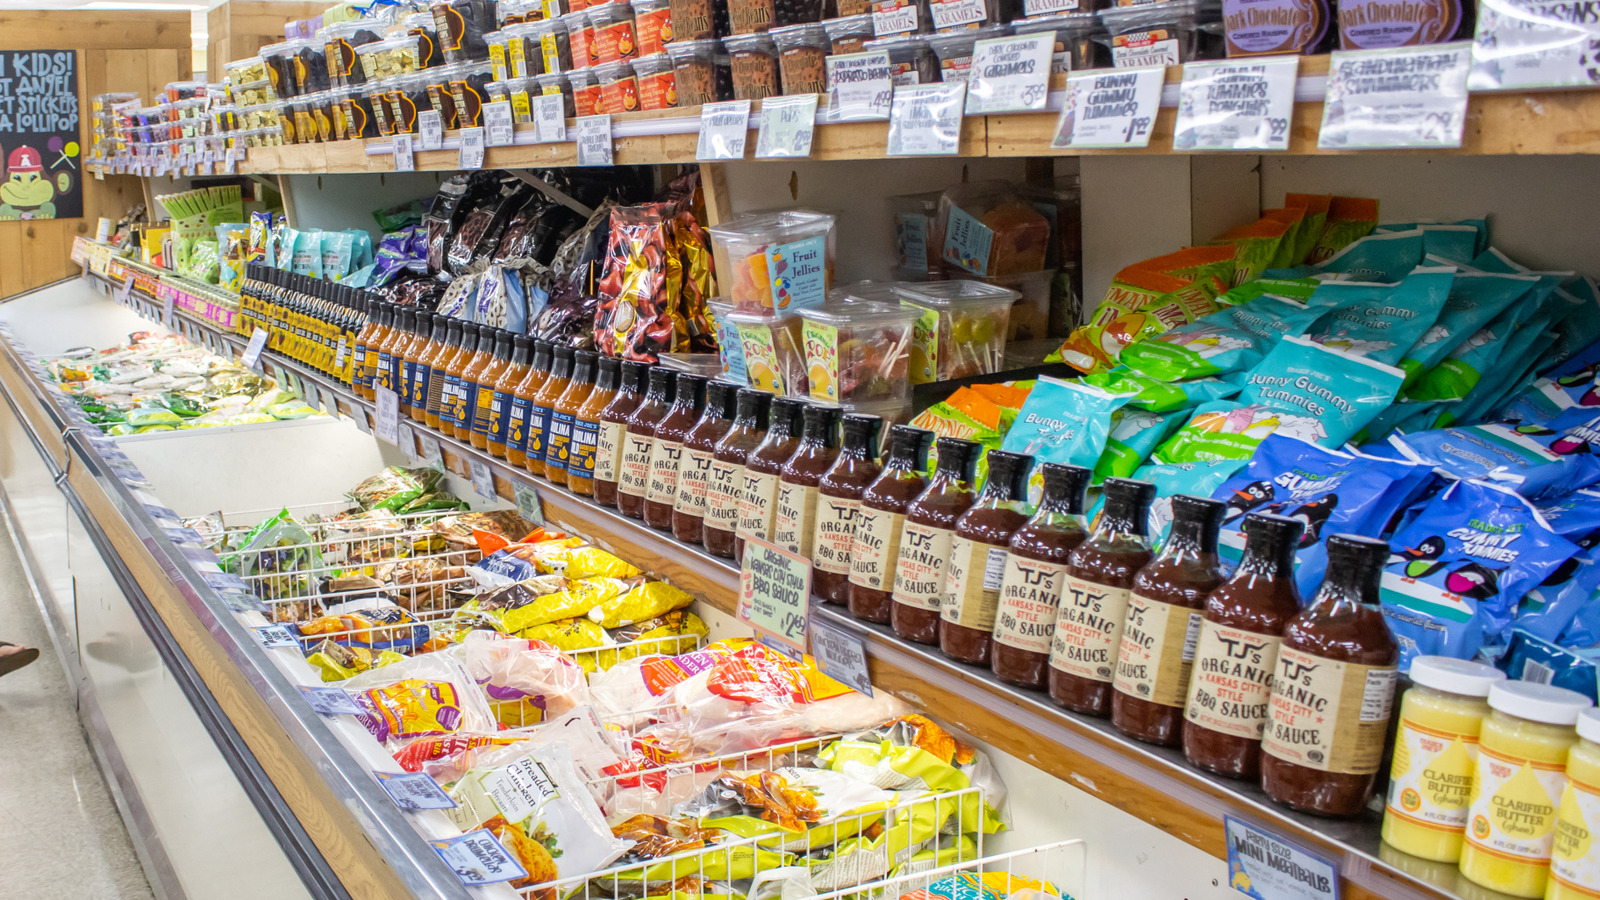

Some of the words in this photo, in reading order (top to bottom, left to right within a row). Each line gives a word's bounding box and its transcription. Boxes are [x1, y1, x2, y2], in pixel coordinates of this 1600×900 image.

[13, 52, 73, 76] KIDS!
[985, 59, 1035, 78] CARAMELS
[16, 115, 80, 133] LOLLIPOP
[793, 250, 818, 264] Fruit
[792, 264, 821, 280] Jellies
[1259, 387, 1325, 417] Tummies
[1025, 413, 1068, 432] Bunny
[712, 508, 738, 520] SAUCE
[1446, 527, 1521, 548] GUMMY
[764, 548, 791, 571] ORGANIC
[819, 544, 834, 561] BBQ
[1460, 541, 1519, 563] TUMMIES
[750, 557, 773, 580] KANSAS
[773, 568, 787, 585] CITY
[786, 573, 805, 591] STYLE
[1016, 561, 1062, 589] TJ's
[753, 573, 771, 598] BBQ
[771, 582, 799, 608] SAUCE
[904, 582, 938, 595] SAUCE
[1007, 599, 1034, 612] KANSAS
[1035, 604, 1054, 615] CITY
[1068, 584, 1110, 614] TJ's
[1000, 612, 1017, 630] BBQ
[1016, 610, 1039, 623] STYLE
[1065, 634, 1087, 647] STYLE
[1083, 627, 1102, 640] CITY
[1068, 644, 1109, 662] SAUCE
[1214, 630, 1272, 665] TJ's
[1201, 657, 1275, 689] ORGANIC
[1281, 658, 1328, 687] TJ's
[1205, 673, 1239, 690] KANSAS
[1240, 681, 1262, 695] CITY
[1195, 688, 1217, 711] BBQ
[1220, 702, 1268, 720] SAUCE
[1216, 687, 1244, 704] STYLE
[1275, 709, 1296, 727] STYLE
[1293, 703, 1313, 720] CITY
[1276, 726, 1321, 746] SAUCE
[520, 758, 555, 798] Breaded
[1423, 769, 1473, 786] CLARIFIE
[1491, 794, 1553, 817] CLARIFIED
[1496, 807, 1544, 827] BUTTER
[1234, 835, 1264, 864] MINI
[1246, 828, 1270, 849] PARTY
[1271, 842, 1292, 860] SIZE
